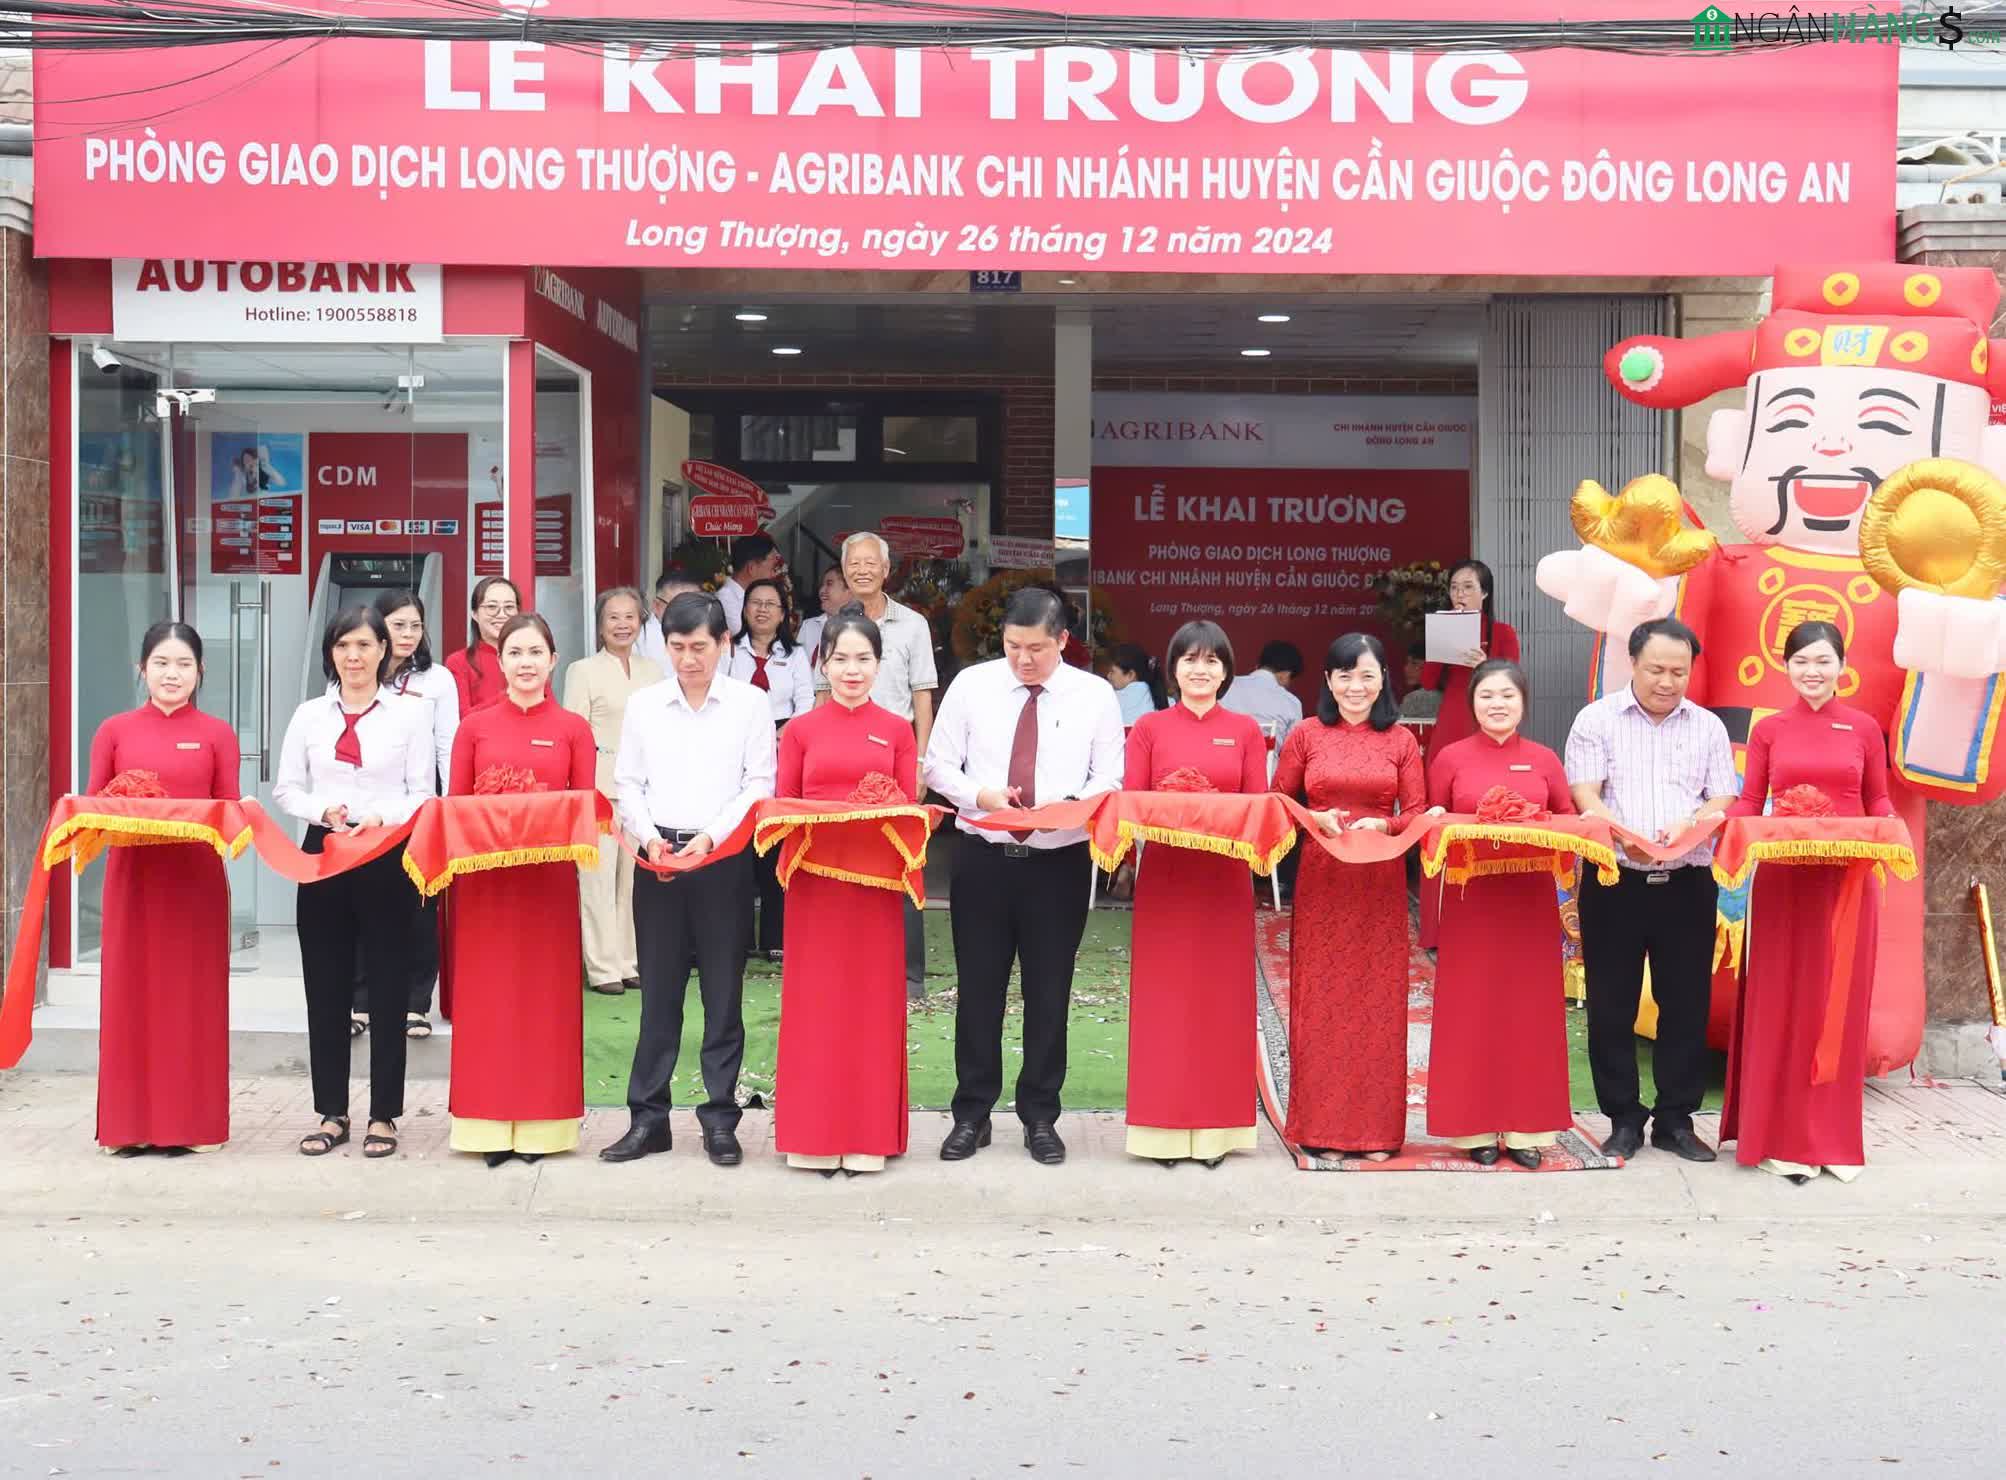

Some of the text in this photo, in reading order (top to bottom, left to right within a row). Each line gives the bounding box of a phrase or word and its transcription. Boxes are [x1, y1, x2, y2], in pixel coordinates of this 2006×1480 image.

[603, 42, 922, 118] KHAI
[86, 128, 1850, 214] PHÒNG GIAO DỊCH LONG THƯỢNG - AGRIBANK CHI NHÁNH HUYỆN CẦN GIUỘC ĐÔNG LONG AN
[626, 219, 1333, 261] Long Thượng, ngày 26 tháng 12 năm 2024
[136, 261, 416, 293] AUTOBANK
[977, 271, 1014, 284] 817
[245, 306, 418, 322] Hotline: 1900558818
[1101, 421, 1264, 441] AGRIBANK
[317, 465, 377, 486] CDM
[1134, 483, 1408, 525] LỄ KHAI TRƯƠNG
[350, 523, 371, 532] VISA
[1148, 540, 1392, 566] PHÒNG GIAO DỊCH LONG THƯỢNG
[1139, 570, 1166, 585] CHI
[1170, 565, 1222, 586] NHÁNH
[1225, 568, 1272, 591] HUYỆN
[1275, 556, 1307, 587] CẦN
[1312, 569, 1360, 590] GIUỘC
[1150, 601, 1178, 617] Long
[1181, 601, 1225, 618] Thượng,
[1228, 602, 1257, 618] ngày
[1260, 602, 1275, 615] 26
[1277, 602, 1311, 618] tháng
[1314, 603, 1328, 616] 12
[1330, 603, 1357, 617] năm
